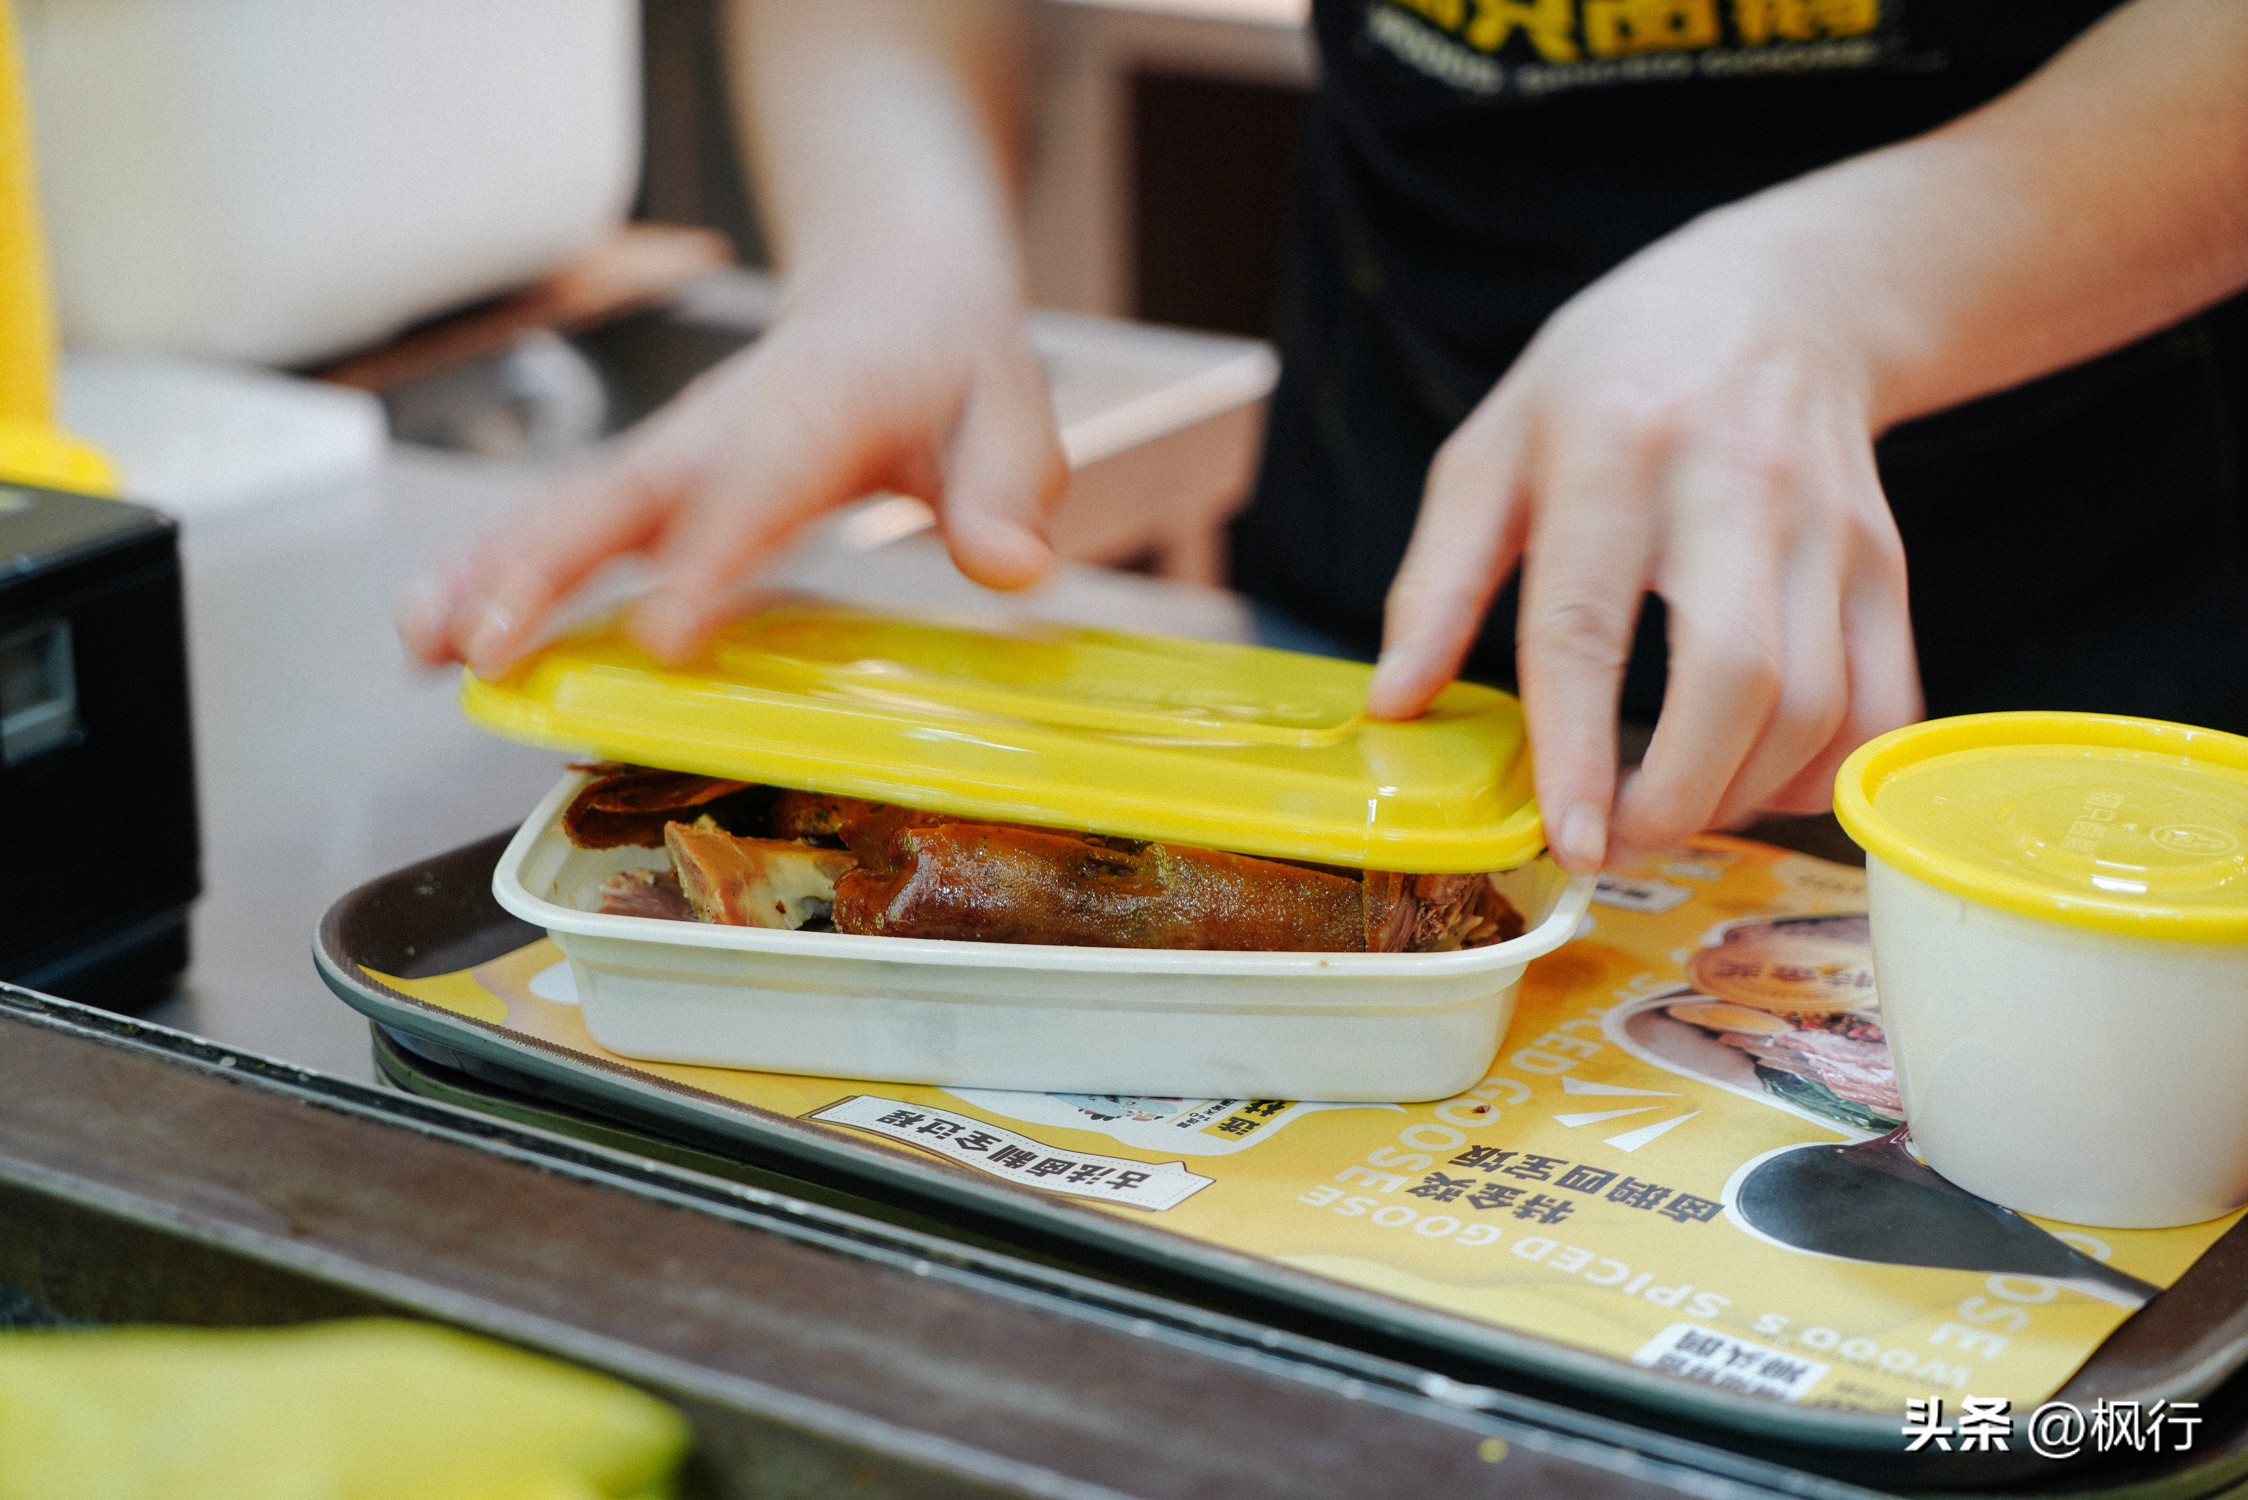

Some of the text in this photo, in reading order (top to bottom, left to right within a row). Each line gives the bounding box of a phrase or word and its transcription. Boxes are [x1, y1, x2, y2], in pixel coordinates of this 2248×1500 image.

[874, 1109, 1152, 1192] 古法卤制全过程
[1332, 1075, 1532, 1195] GOOSE
[1296, 1183, 1503, 1247] GOOSE
[1405, 1170, 1577, 1225] 特金奖
[1448, 1143, 1726, 1225] 卤鹅四宝饭
[1510, 1236, 1733, 1319] SPICED
